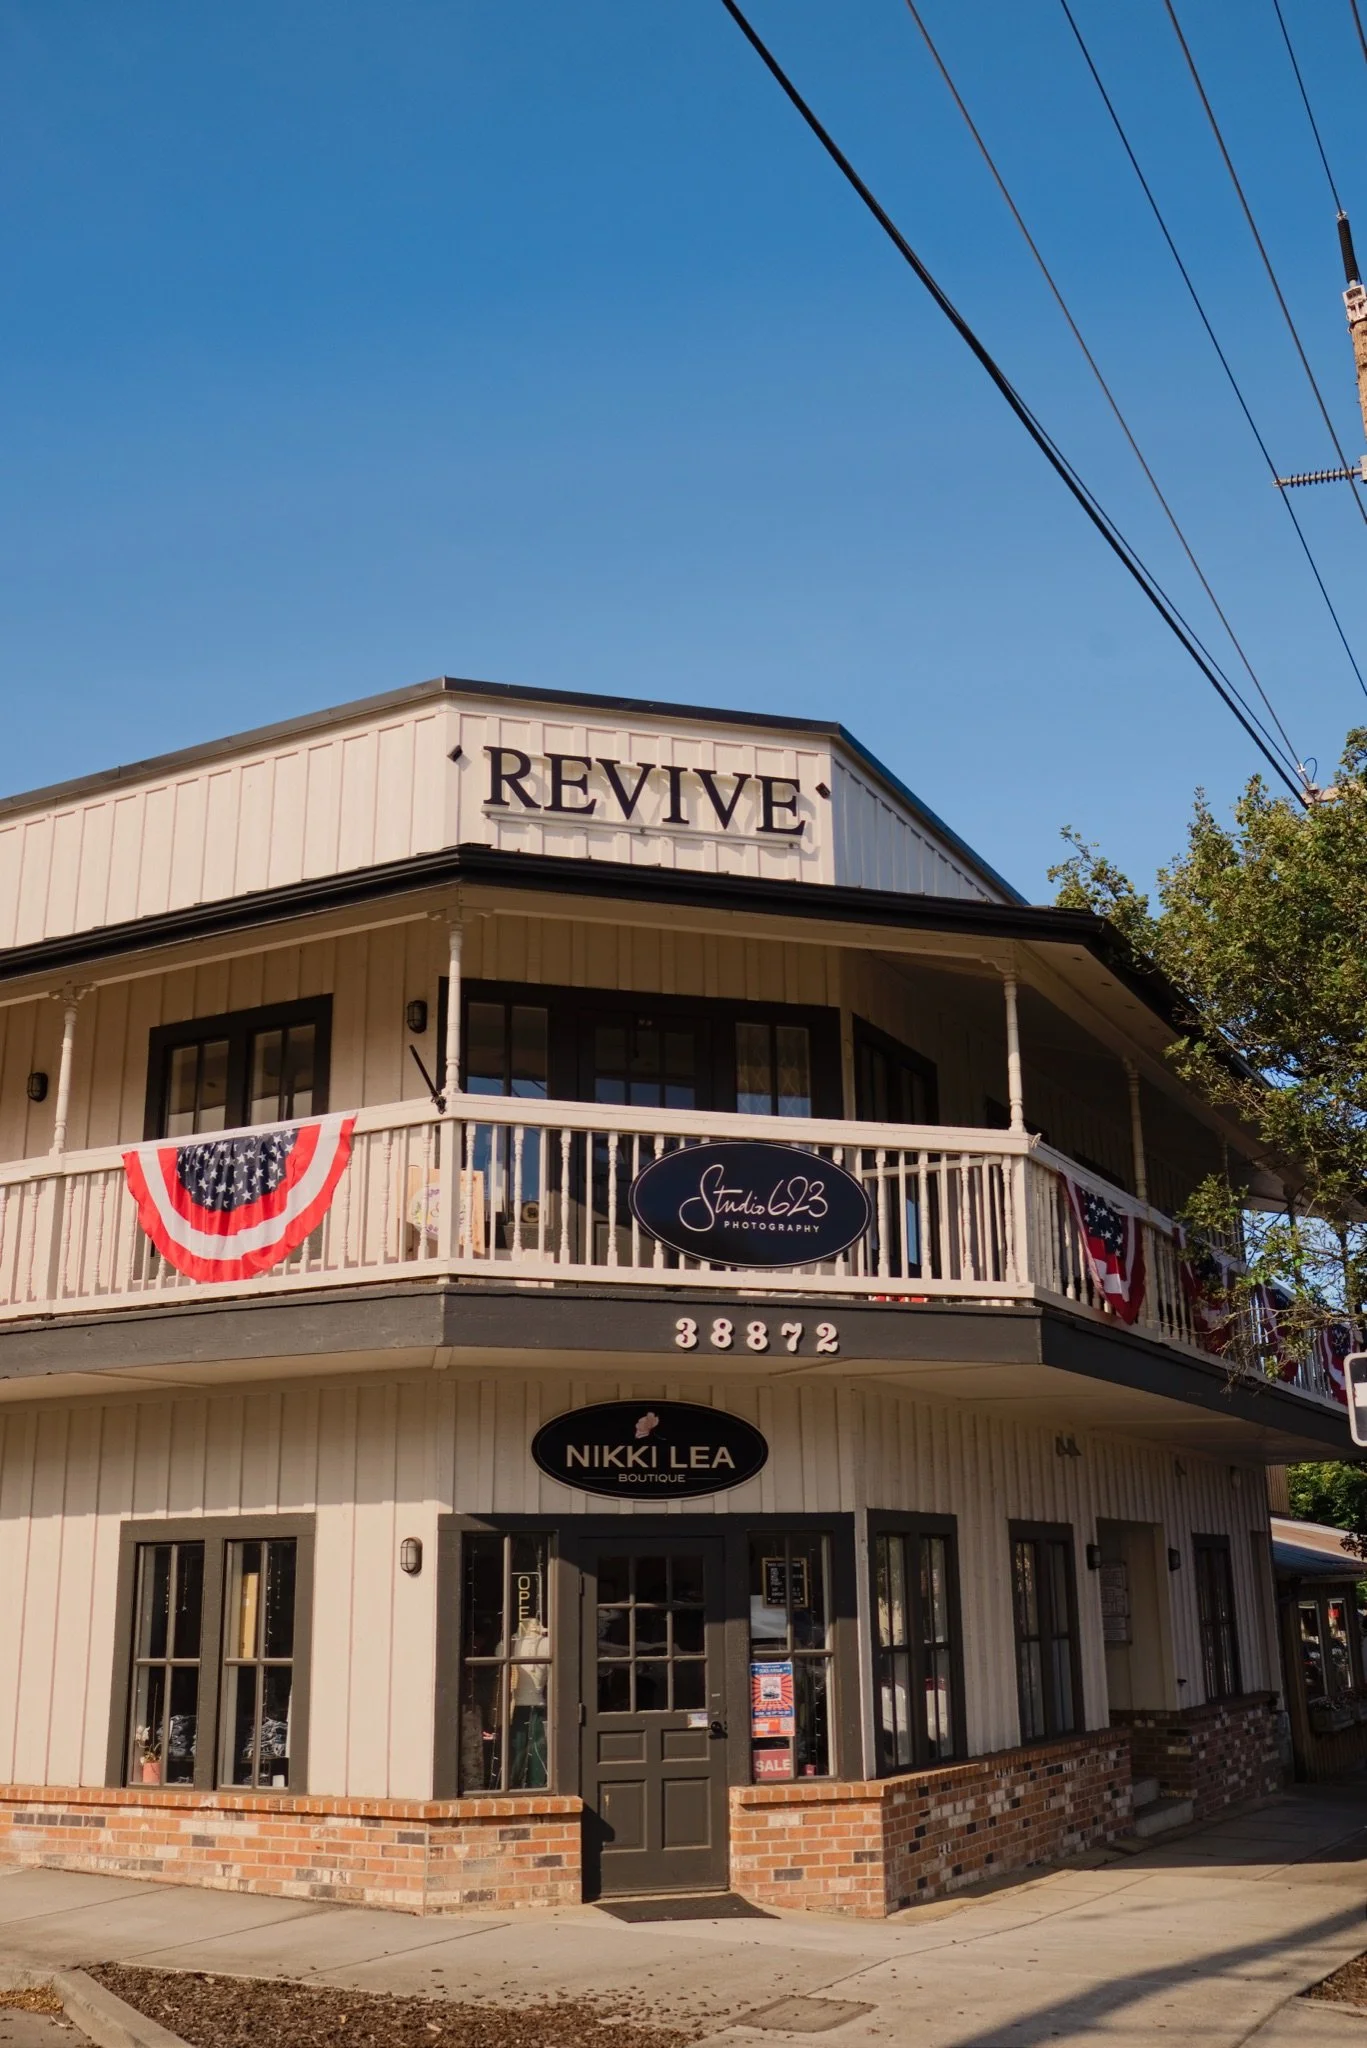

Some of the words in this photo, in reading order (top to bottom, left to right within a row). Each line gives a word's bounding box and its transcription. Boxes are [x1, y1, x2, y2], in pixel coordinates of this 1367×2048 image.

[483, 745, 806, 836] REVIVE
[723, 1220, 820, 1233] PHOTOGRAPHY
[675, 1317, 839, 1352] 38872
[566, 1444, 657, 1468] NIKKI
[670, 1445, 736, 1469] LEA
[618, 1473, 686, 1483] BOUTIQUE
[755, 1759, 791, 1772] SALE
